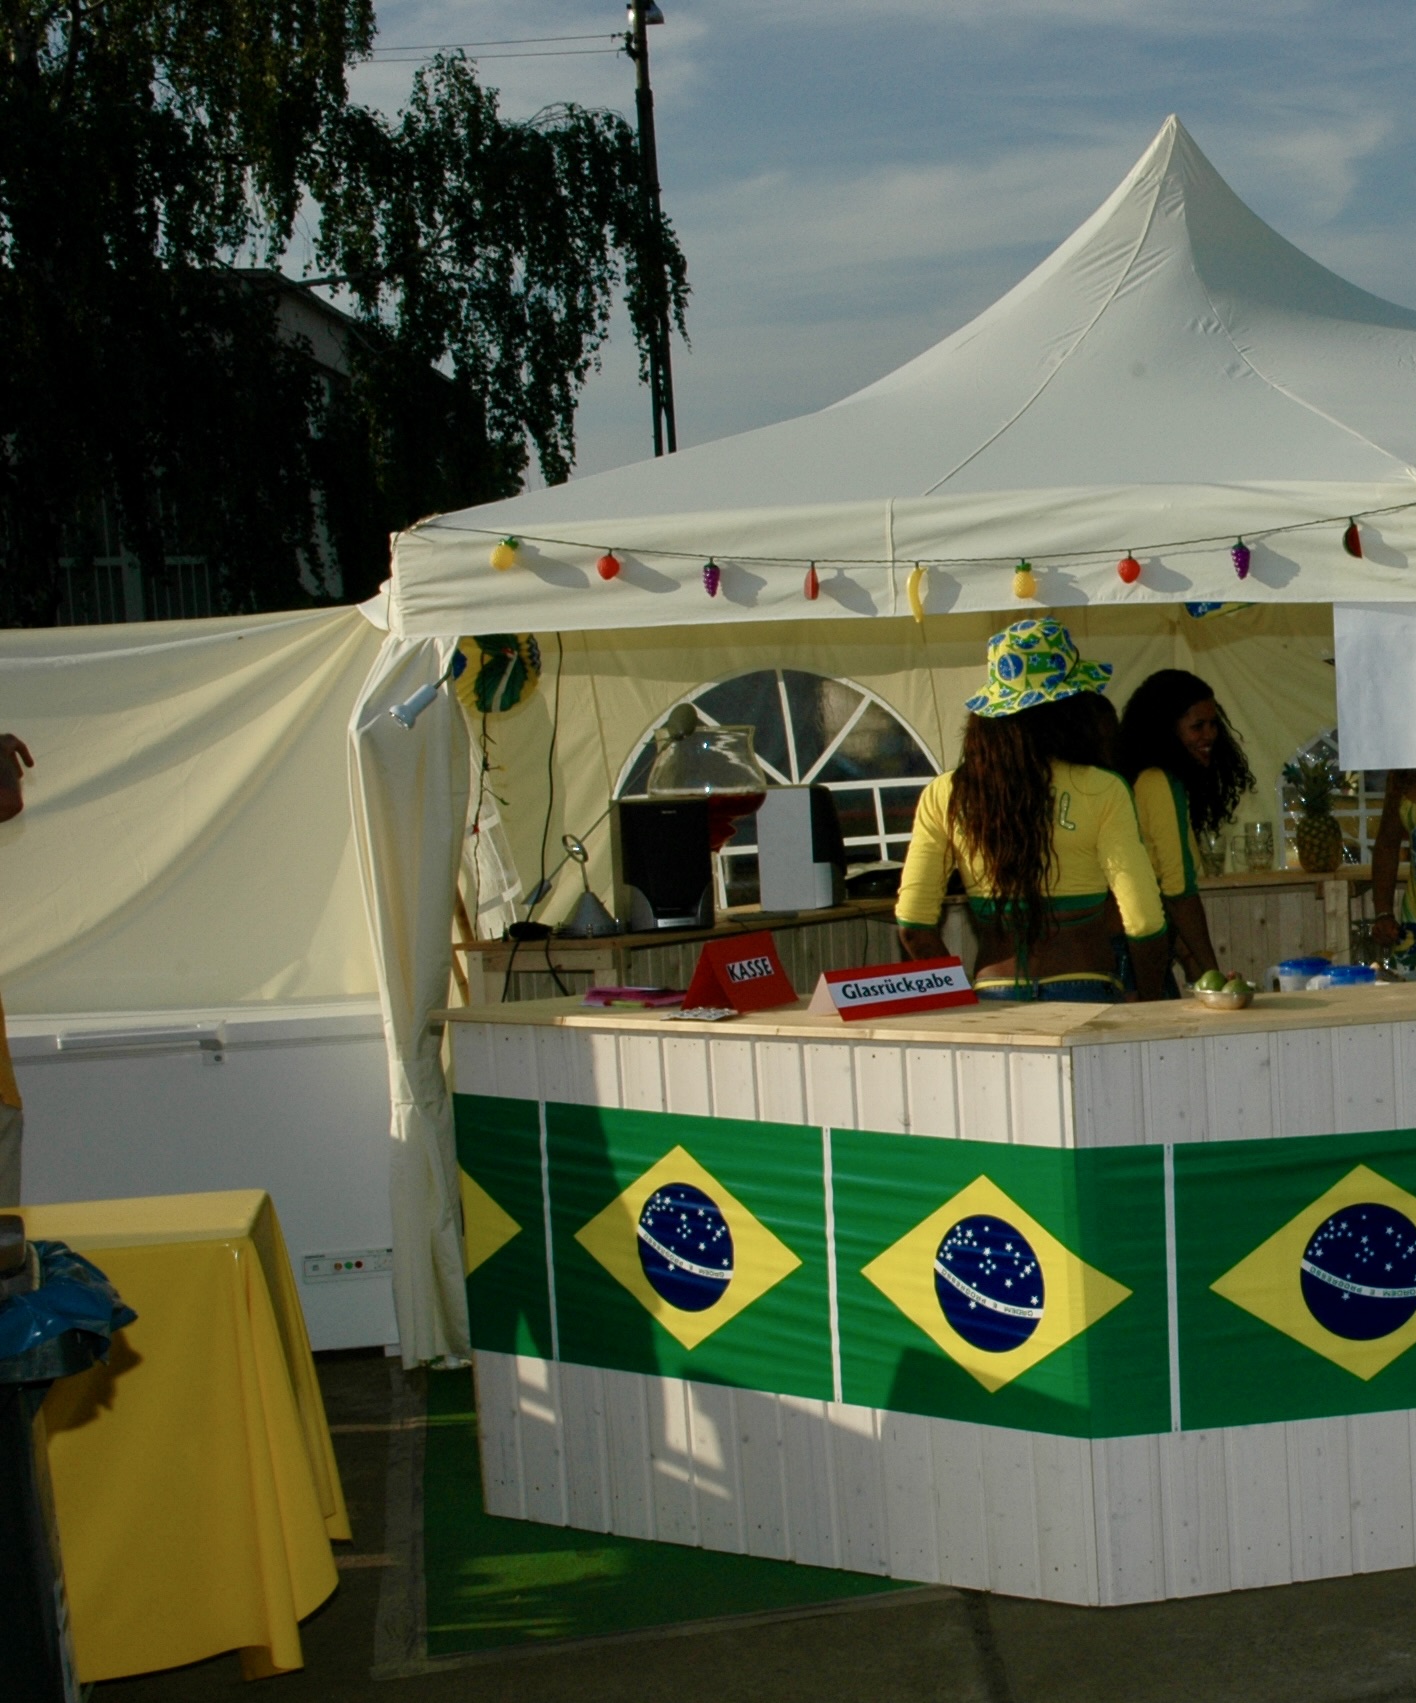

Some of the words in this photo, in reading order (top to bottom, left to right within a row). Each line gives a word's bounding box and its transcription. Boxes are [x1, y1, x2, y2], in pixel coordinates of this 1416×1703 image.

[727, 956, 773, 983] KASSE
[842, 972, 954, 1001] Glasrückgabe
[1383, 1288, 1416, 1296] ORDEM
[1004, 1306, 1034, 1317] ORDEM
